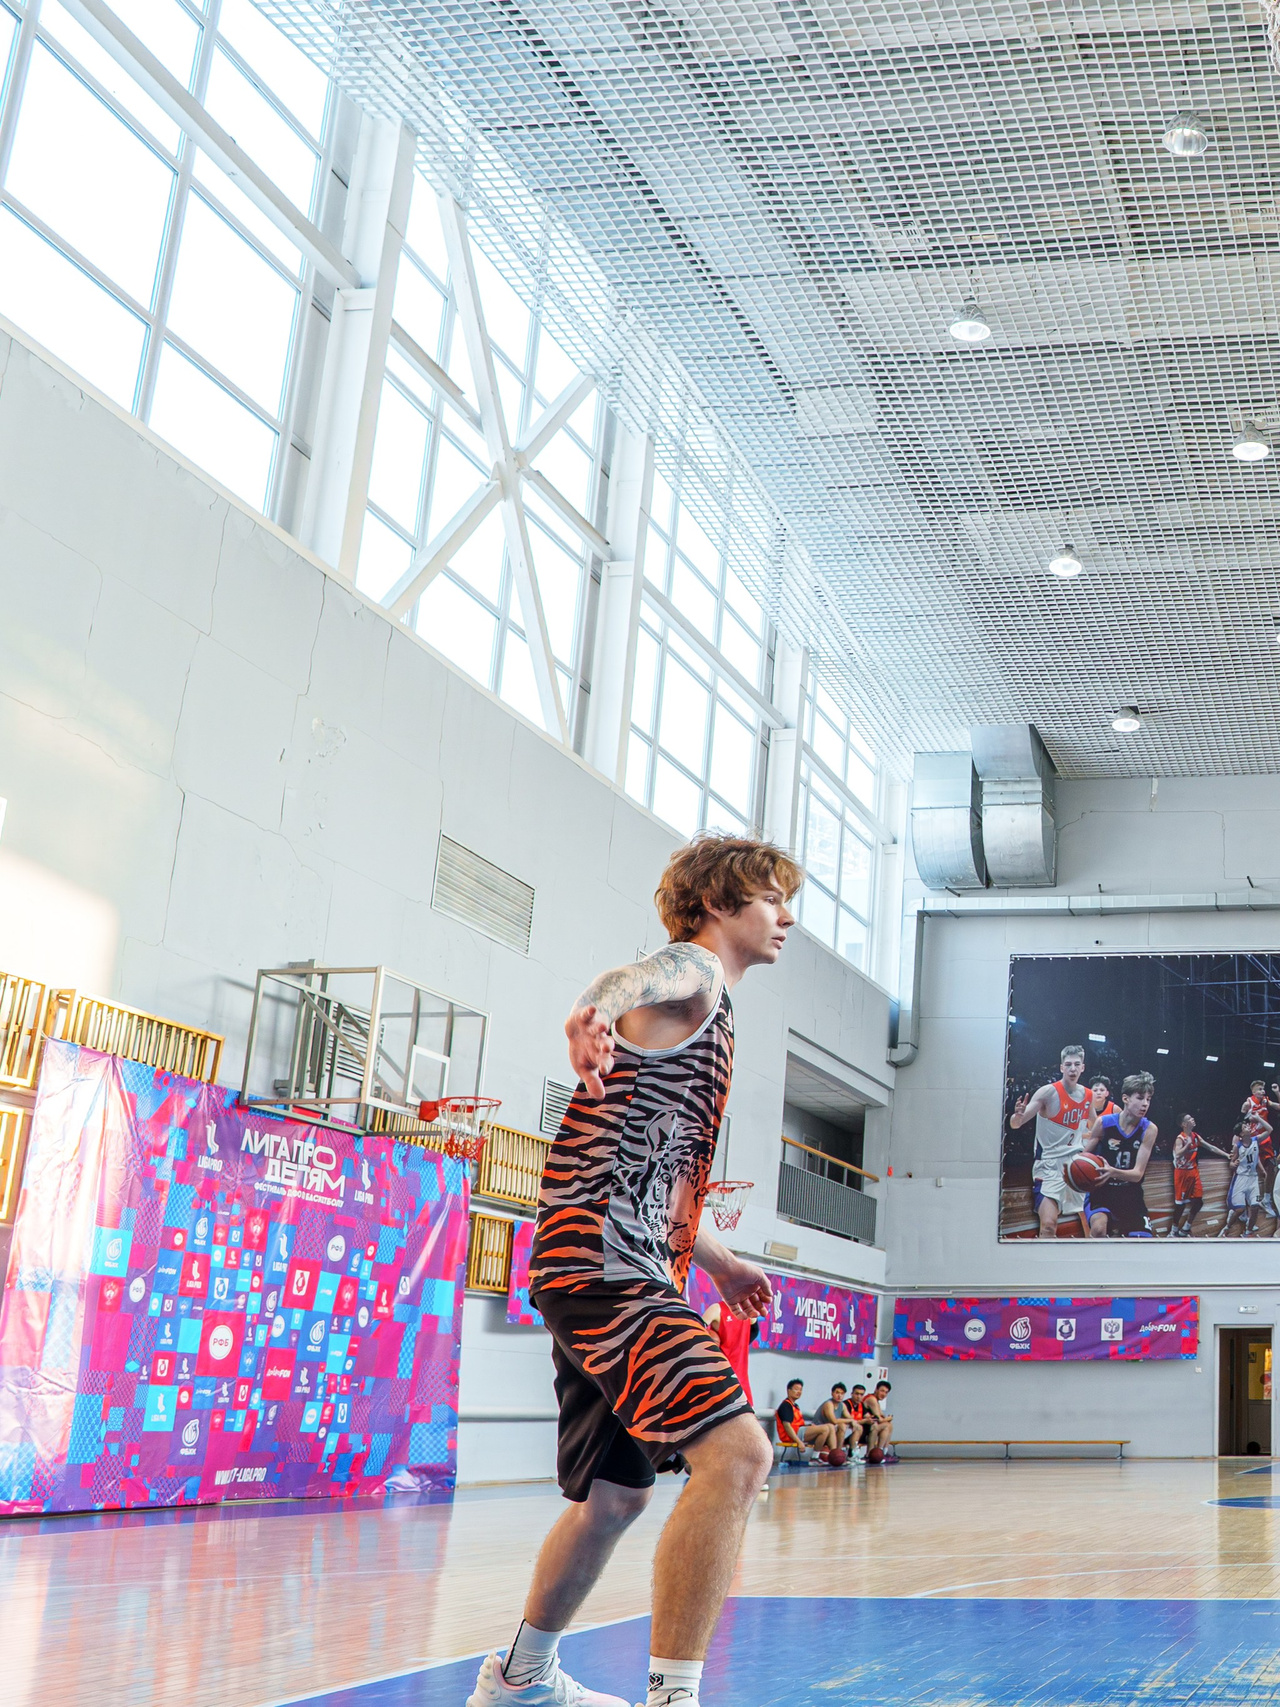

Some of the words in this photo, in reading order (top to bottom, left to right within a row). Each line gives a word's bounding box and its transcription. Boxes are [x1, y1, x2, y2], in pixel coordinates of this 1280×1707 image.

[1063, 1108, 1086, 1126] ЦСК
[264, 1158, 346, 1198] ДЕТЯМ
[805, 1318, 840, 1342] ДЕТЯМ
[213, 1338, 229, 1347] РФБ
[1009, 1342, 1031, 1350] ФБХК
